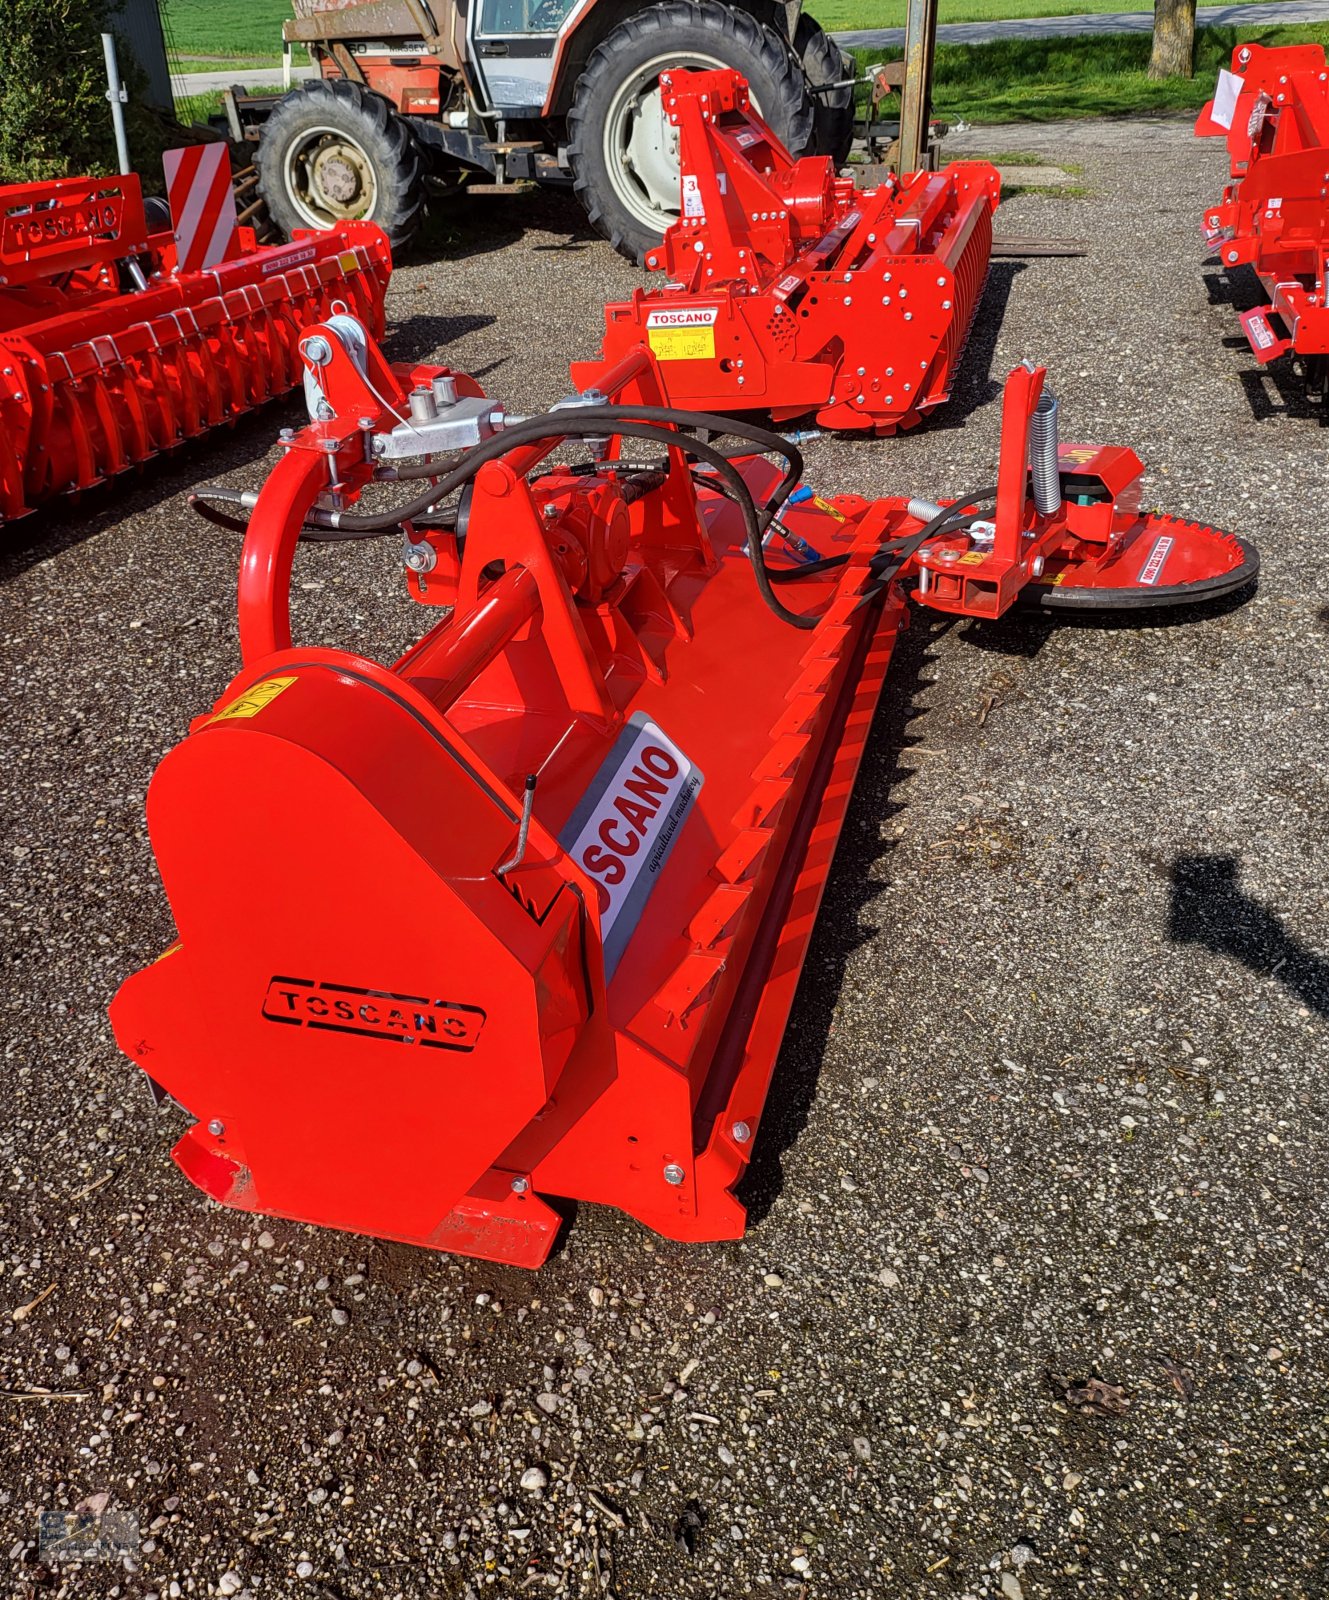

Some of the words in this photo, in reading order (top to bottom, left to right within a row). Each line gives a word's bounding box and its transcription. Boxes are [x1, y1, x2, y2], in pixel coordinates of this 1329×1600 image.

[10, 206, 117, 245] TOSCANO
[652, 312, 712, 325] TOSCANO
[649, 814, 679, 873] agricultural
[675, 776, 701, 819] machinery
[279, 990, 468, 1038] TOSCANO
